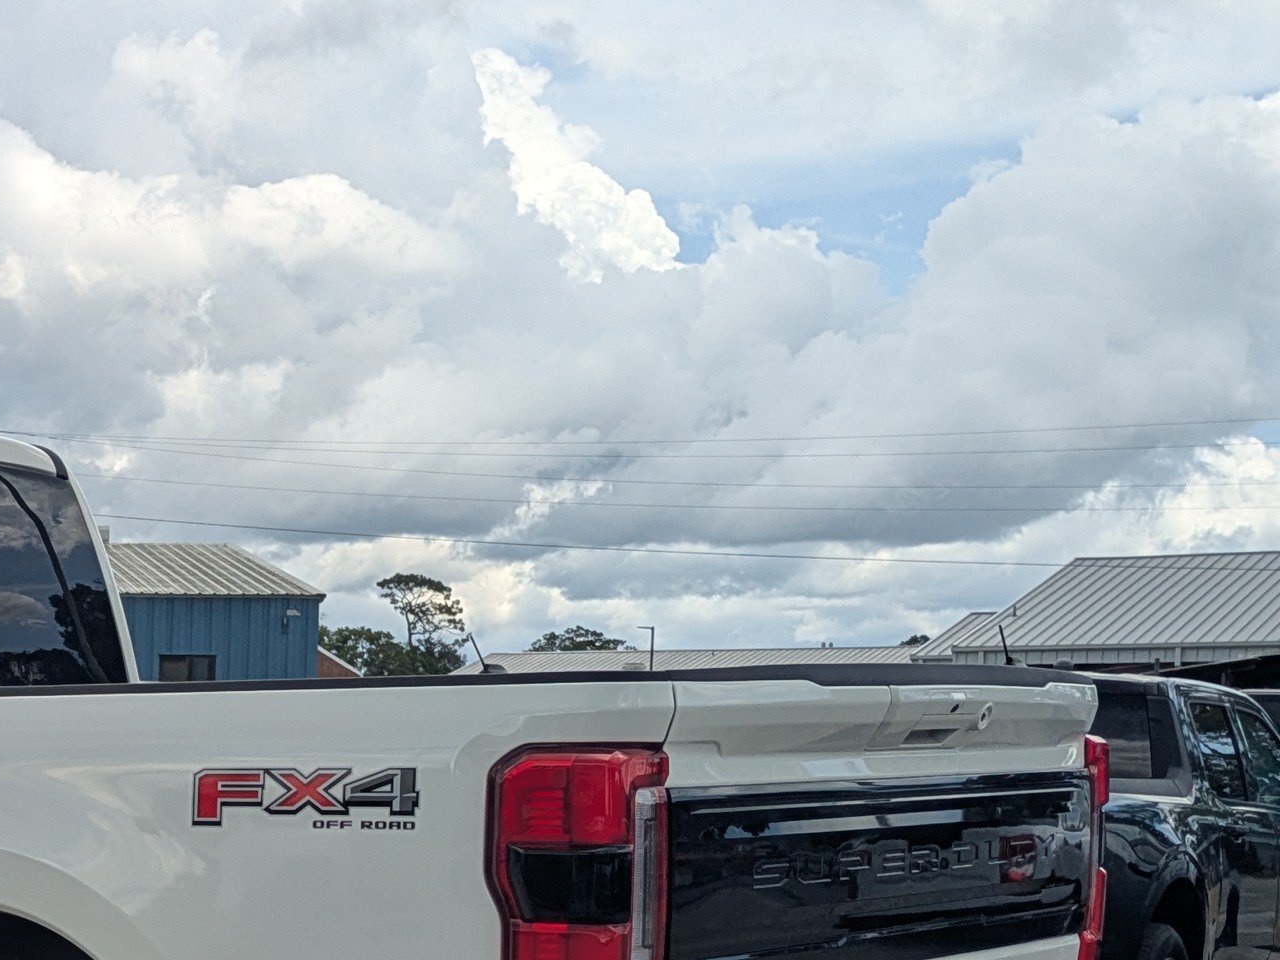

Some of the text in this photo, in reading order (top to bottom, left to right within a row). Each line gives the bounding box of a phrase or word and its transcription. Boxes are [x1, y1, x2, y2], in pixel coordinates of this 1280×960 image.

[192, 767, 420, 827] FX4
[312, 819, 416, 831] OFF ROAD
[752, 833, 1055, 890] SUPER DUTY
